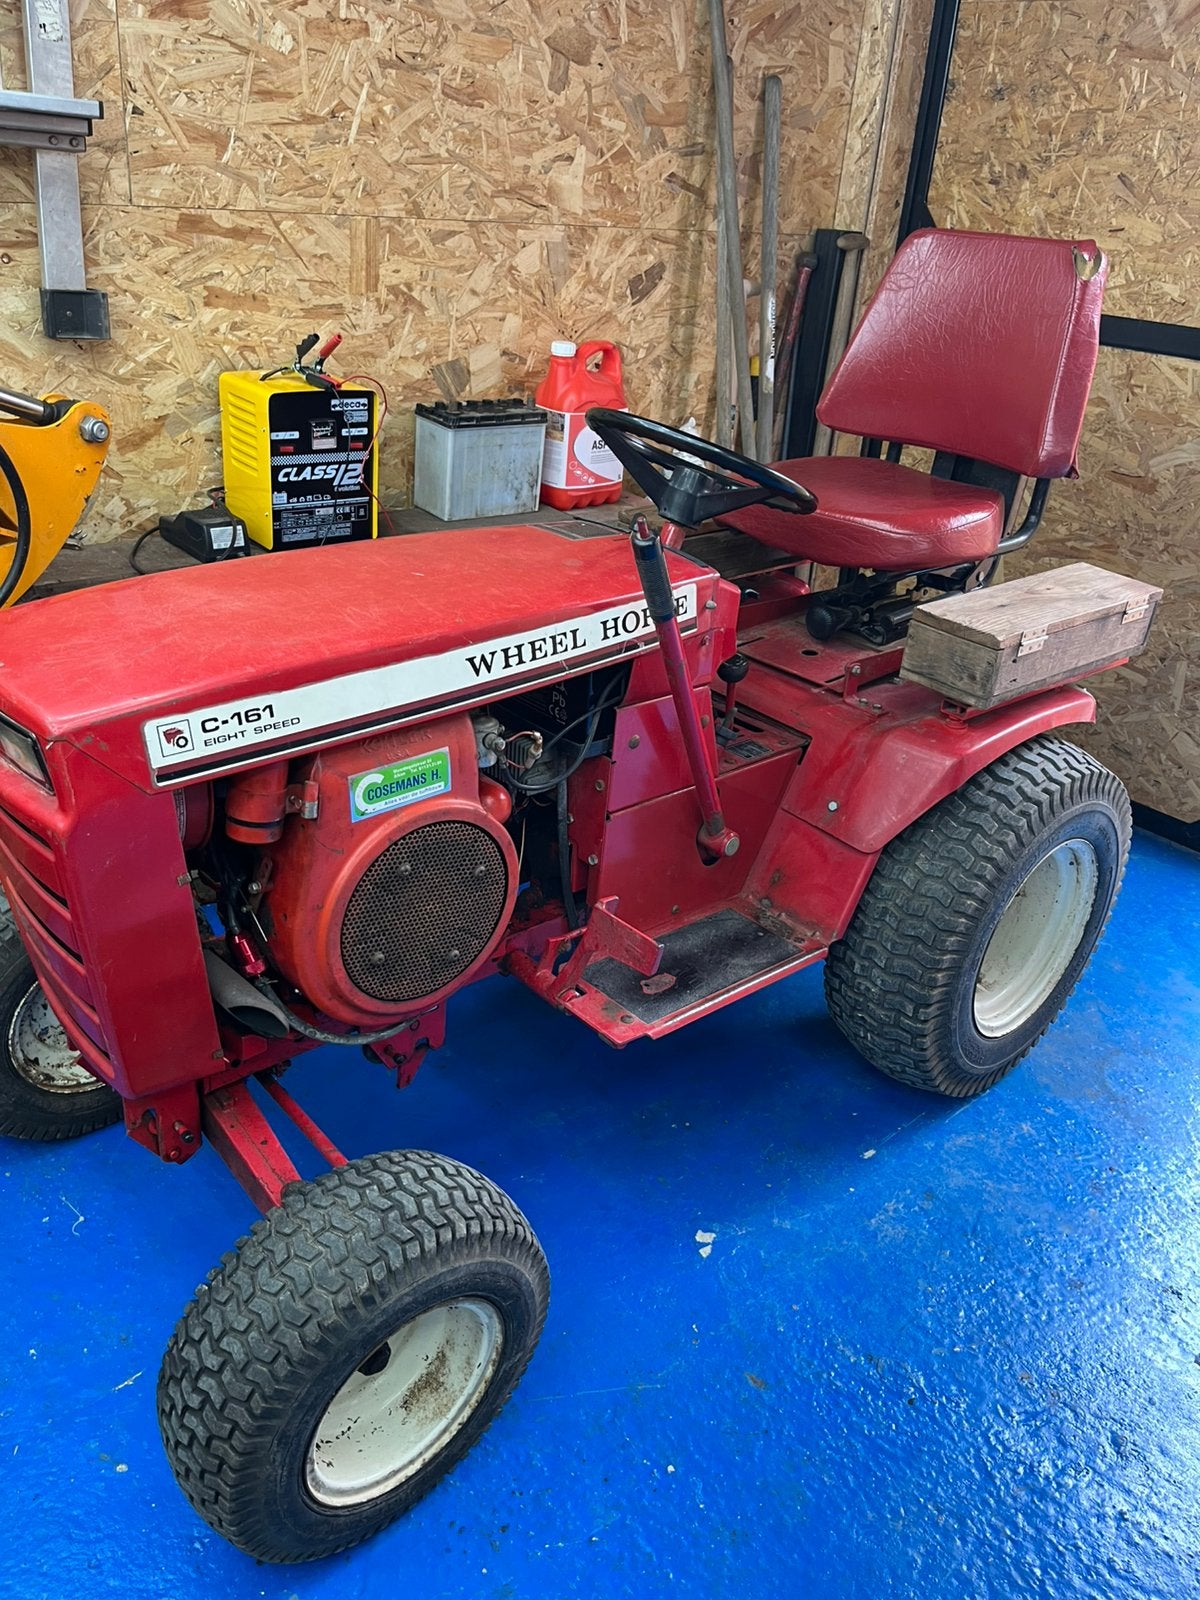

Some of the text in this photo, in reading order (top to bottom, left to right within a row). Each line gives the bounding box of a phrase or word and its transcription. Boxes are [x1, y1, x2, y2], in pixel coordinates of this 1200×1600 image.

[338, 399, 361, 409] deca
[465, 594, 688, 678] WHEEL HOE
[552, 691, 566, 708] Pb
[201, 704, 275, 734] C-161
[204, 717, 301, 747] EIGHT SPEED
[367, 772, 427, 801] COSEMANS
[431, 768, 442, 781] H.
